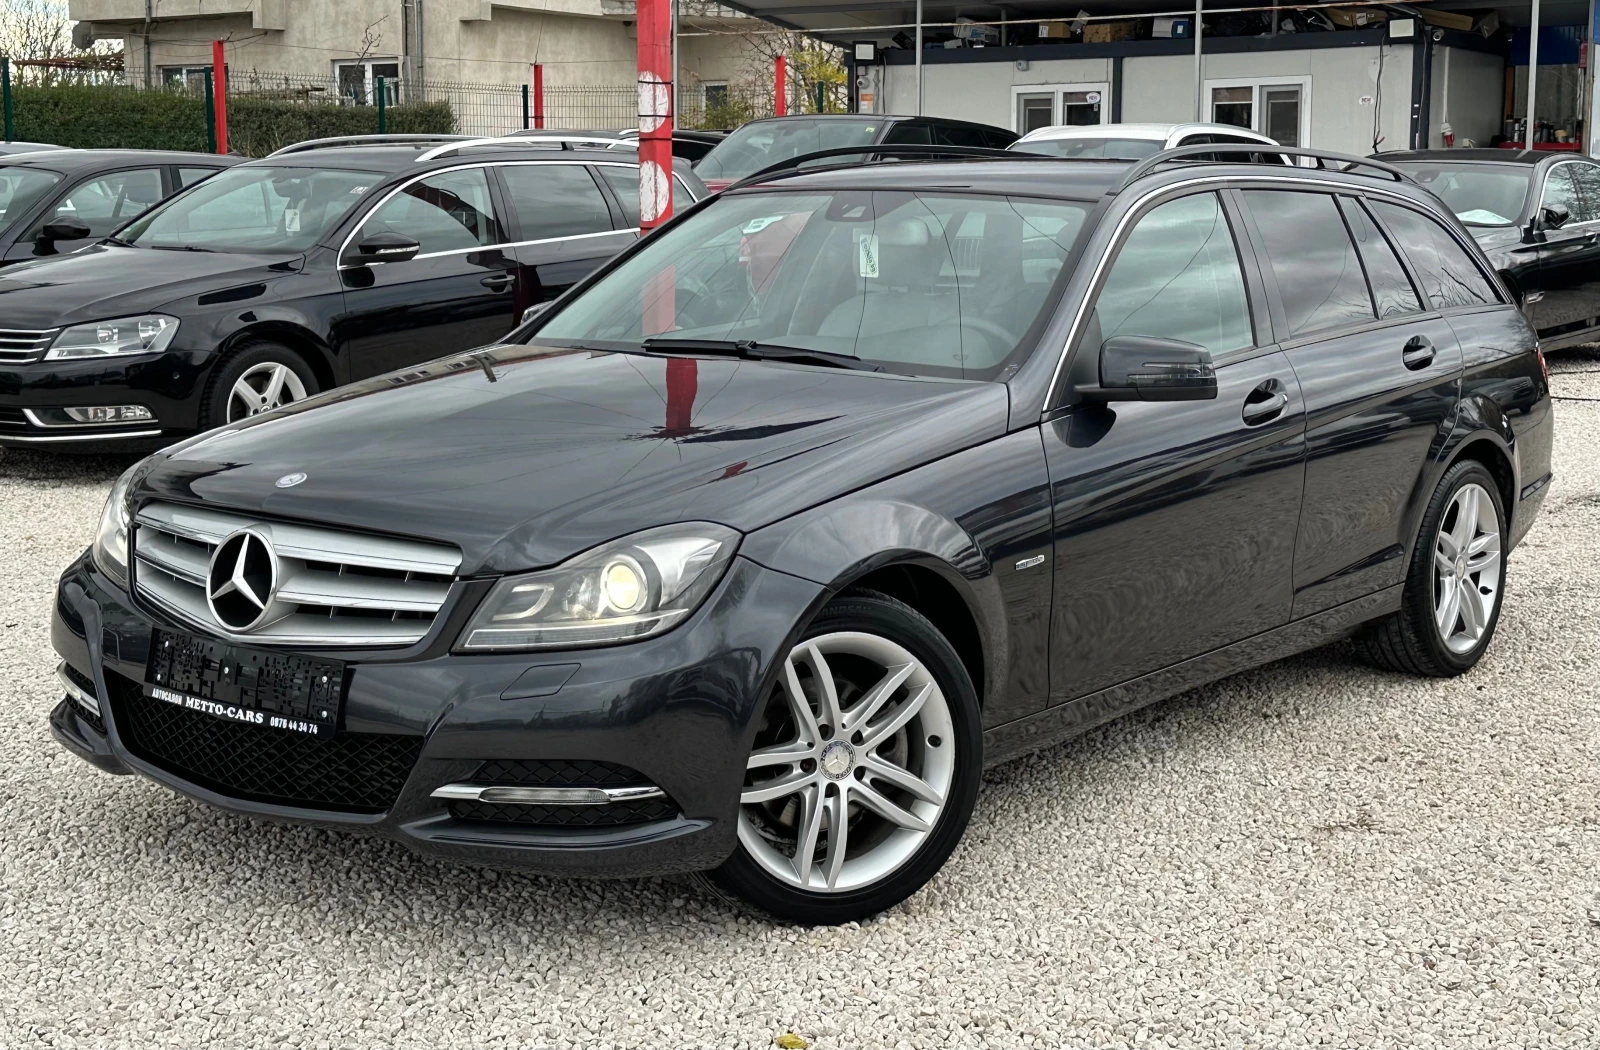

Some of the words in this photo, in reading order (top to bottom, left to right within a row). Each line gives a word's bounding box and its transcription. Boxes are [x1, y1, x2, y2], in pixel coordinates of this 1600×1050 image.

[186, 697, 264, 723] METTO-CARS
[288, 719, 298, 731] 44
[298, 721, 308, 733] 34
[308, 723, 318, 735] 74
